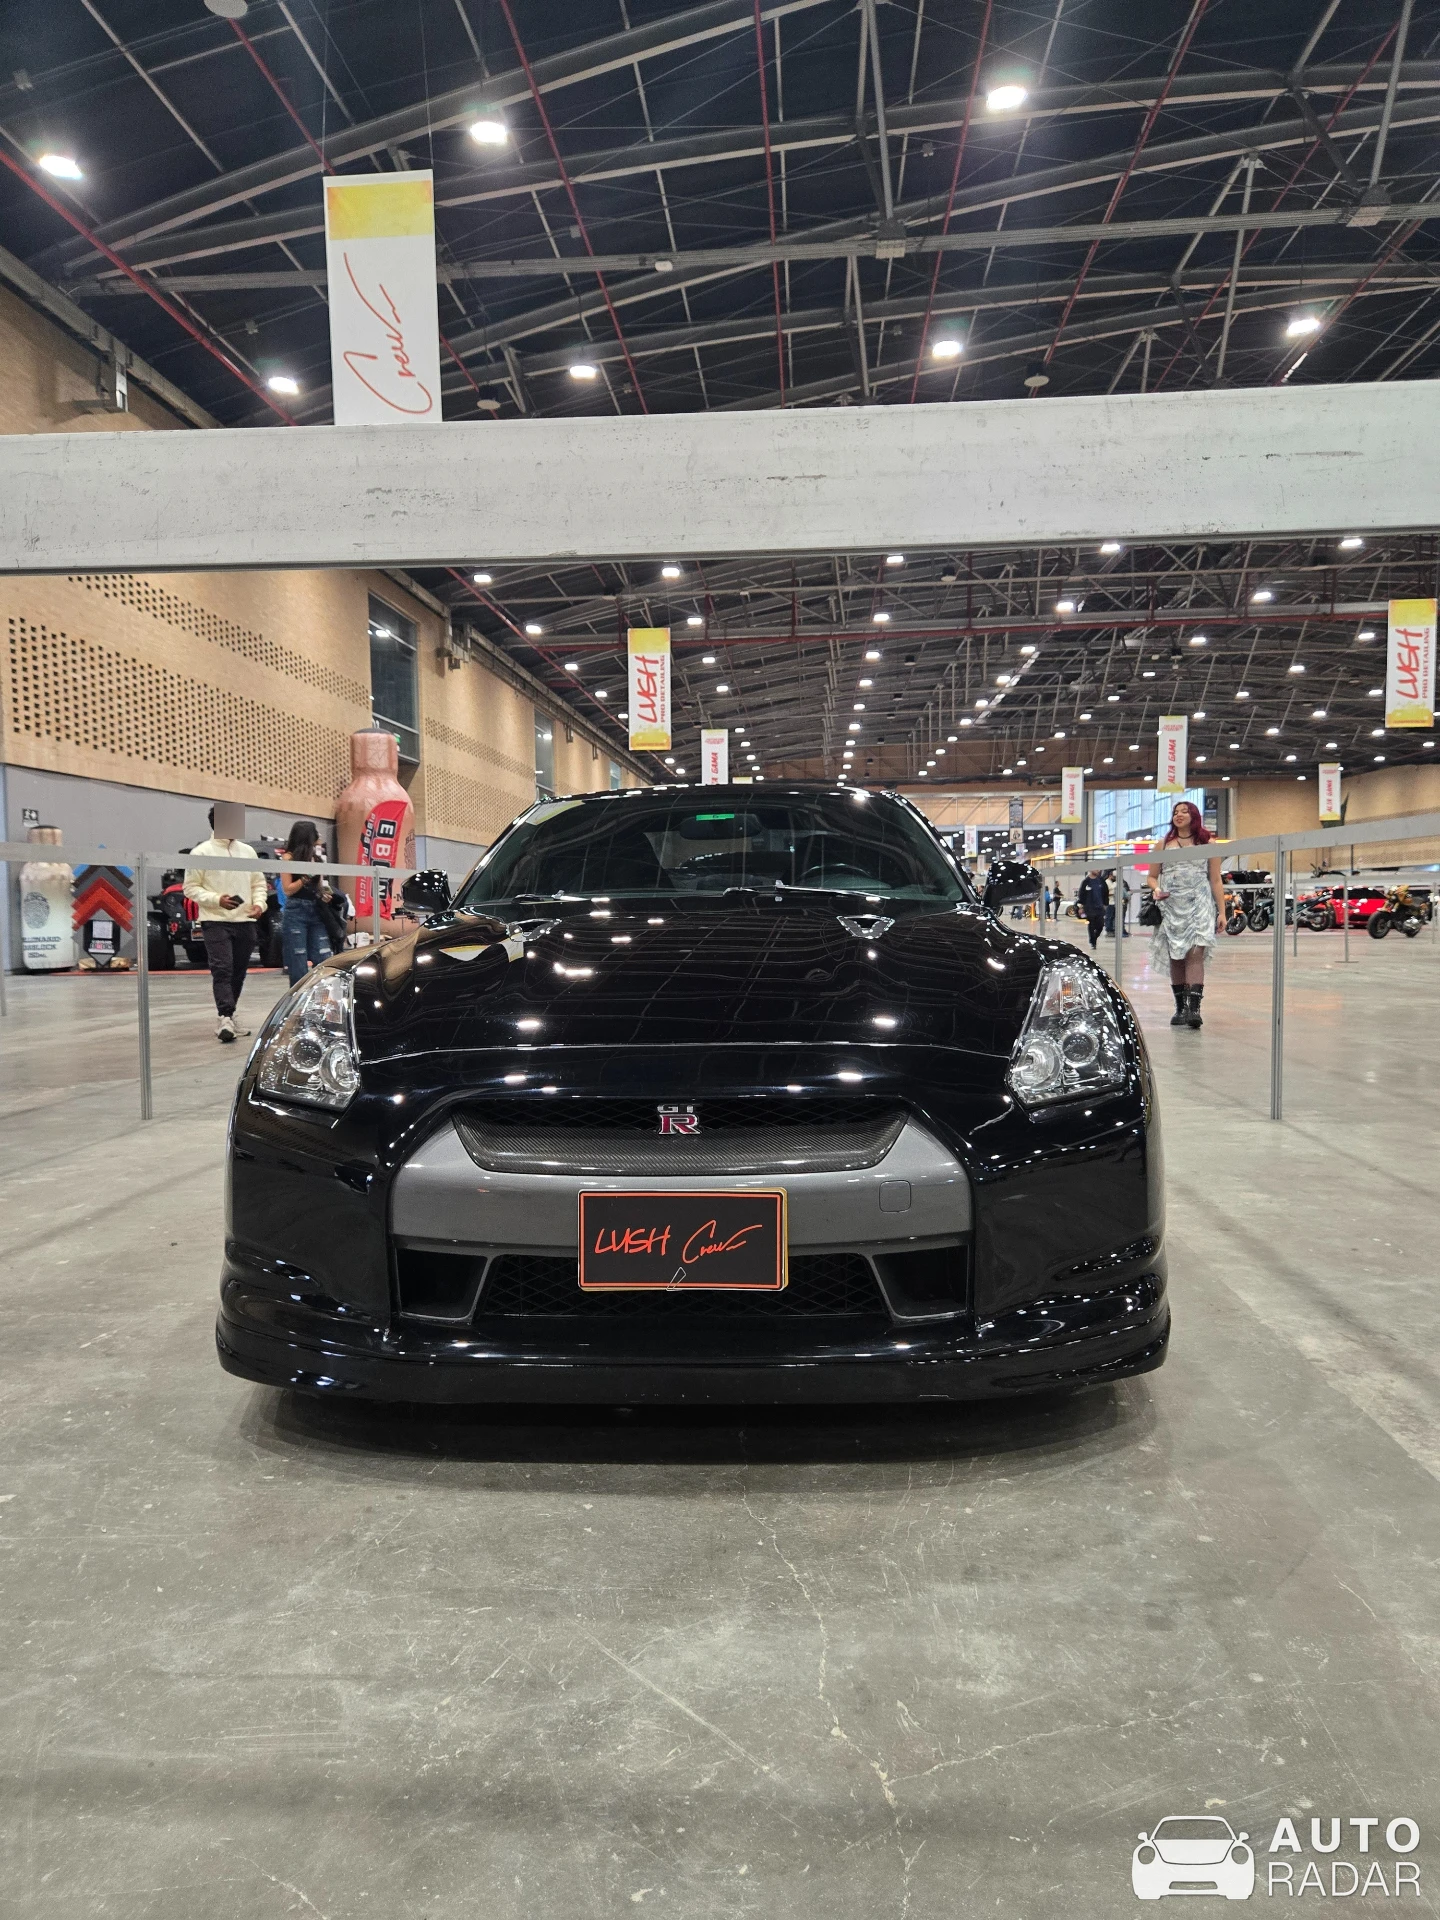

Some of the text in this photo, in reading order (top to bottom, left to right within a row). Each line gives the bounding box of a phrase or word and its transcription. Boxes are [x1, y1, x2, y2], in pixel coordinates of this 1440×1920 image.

[1395, 628, 1423, 699] LUSH
[635, 655, 659, 723] LUSH
[1167, 739, 1177, 762] GAMA
[1167, 765, 1176, 784] ALTA
[658, 1113, 701, 1135] R
[594, 1225, 671, 1256] LUSH
